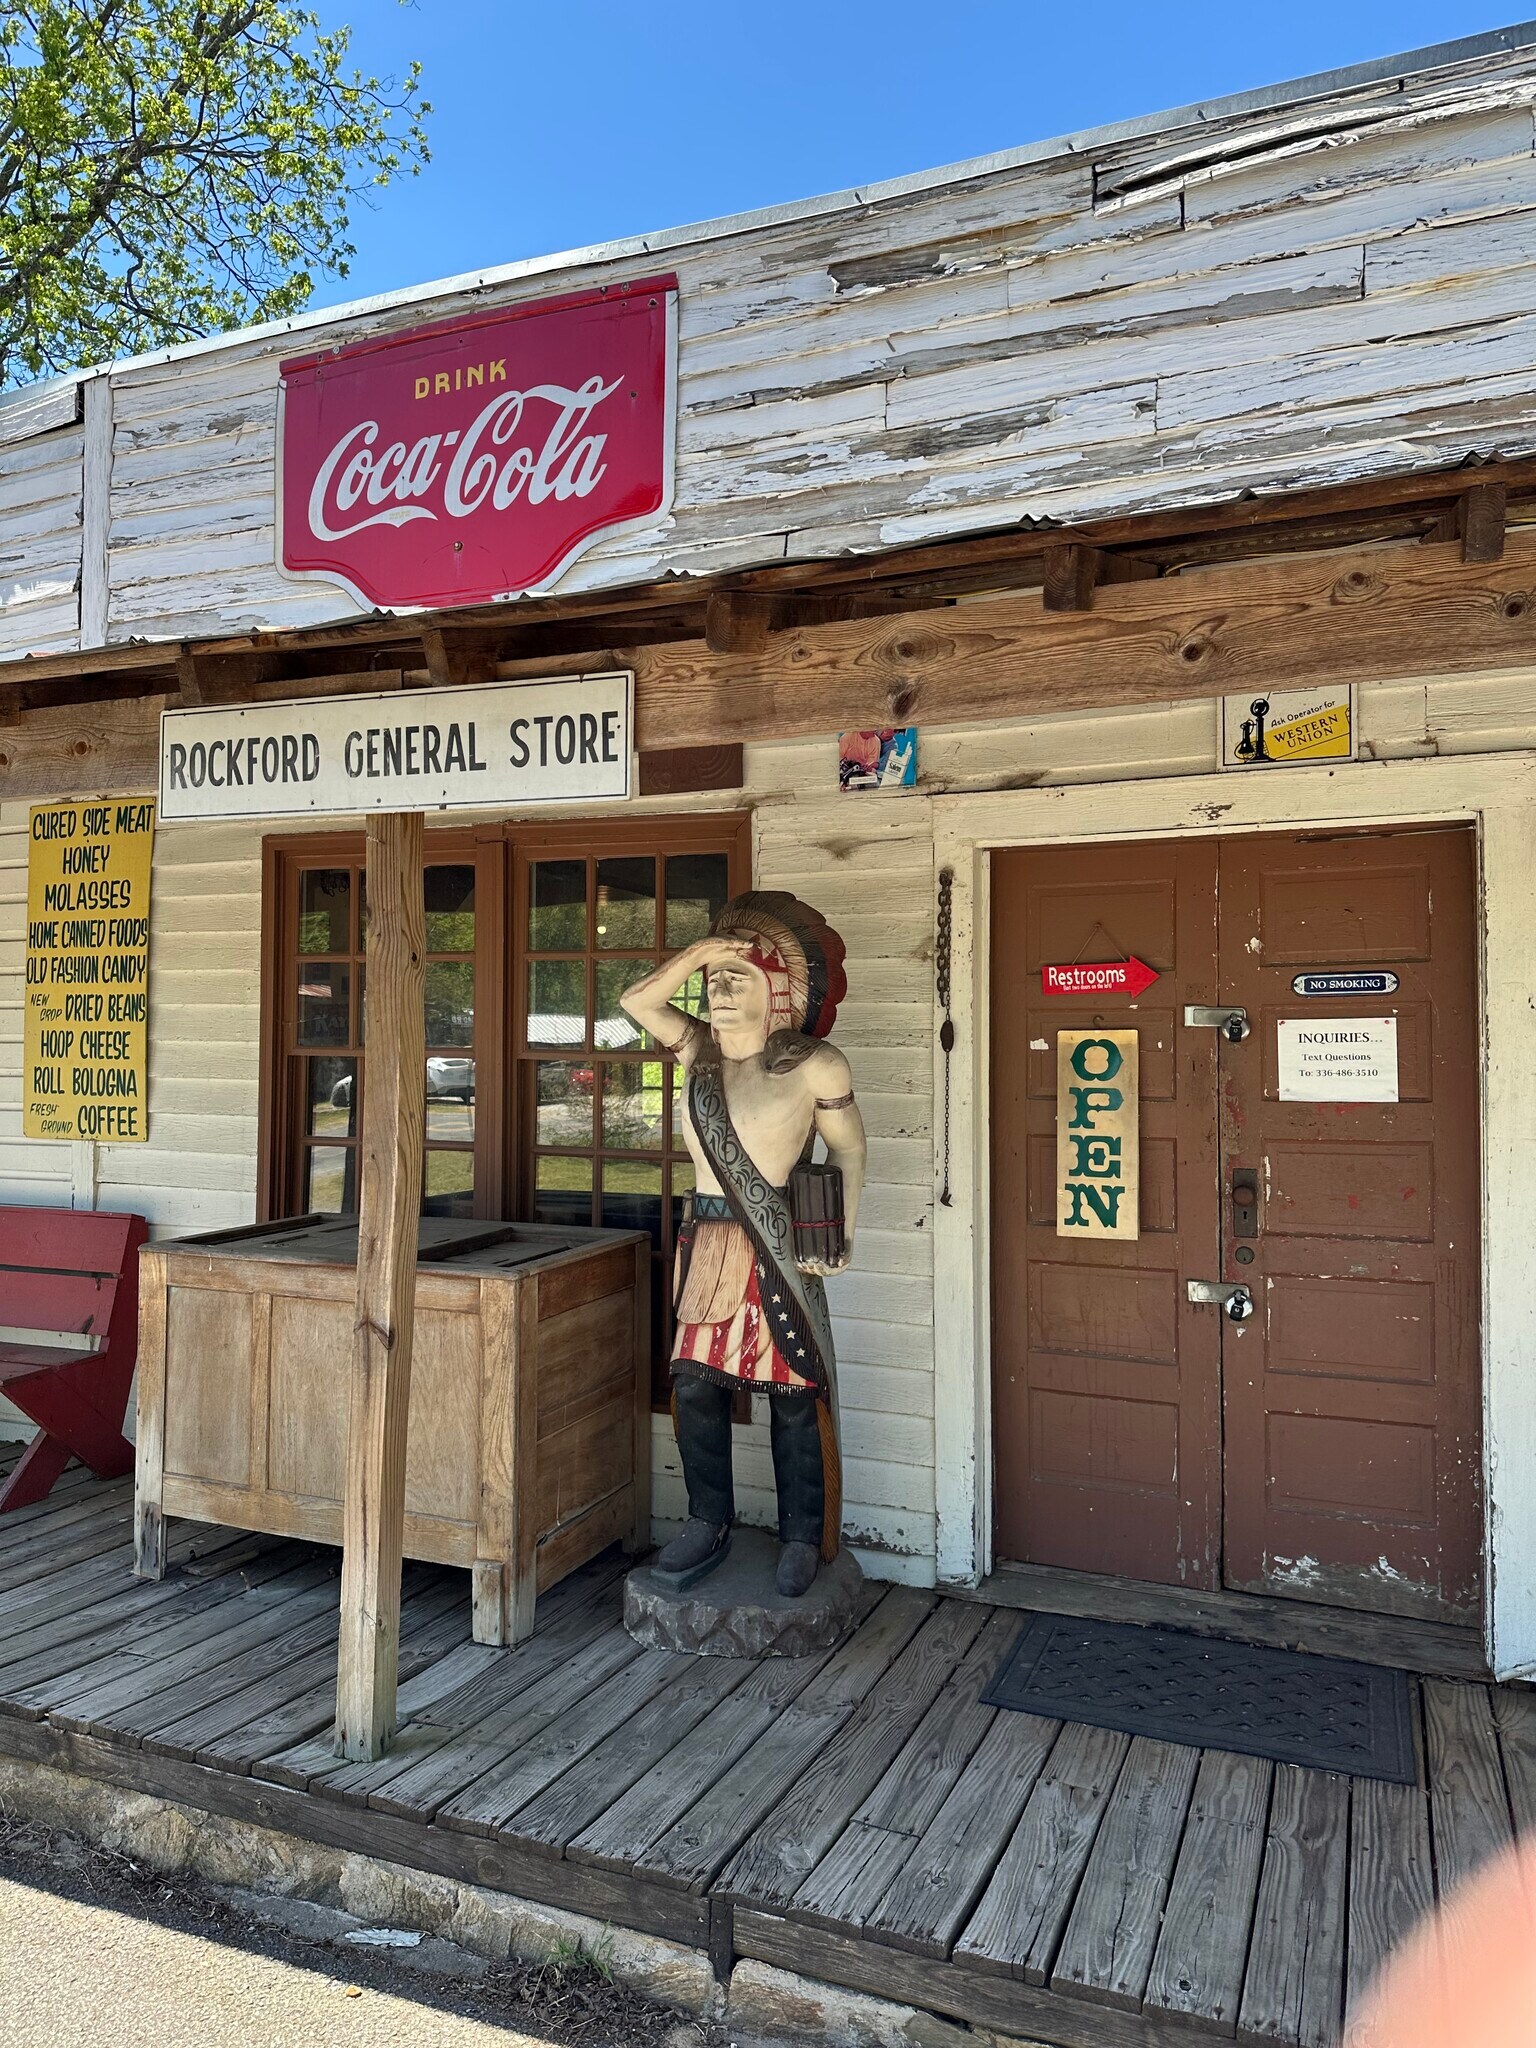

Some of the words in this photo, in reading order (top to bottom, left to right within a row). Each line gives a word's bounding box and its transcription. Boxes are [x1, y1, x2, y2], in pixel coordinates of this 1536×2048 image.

[415, 358, 507, 399] DRINK
[308, 374, 624, 542] Coca-Cola
[1271, 718, 1286, 727] Ask
[1287, 706, 1322, 722] Operator
[1324, 700, 1336, 708] for
[1274, 714, 1338, 743] WESTERN
[1287, 726, 1334, 748] UNION
[170, 733, 320, 790] ROCKFORD
[344, 722, 486, 778] GENERAL
[510, 711, 618, 768] STORE
[32, 809, 76, 840] CURED
[82, 806, 112, 838] SIDE
[115, 804, 155, 834] MEAT
[62, 844, 110, 874] HONEY
[44, 880, 131, 912] MOLASSES
[29, 921, 60, 950] HOME
[62, 919, 106, 948] CANNED
[108, 917, 148, 947] FOODS
[26, 957, 48, 984] OLD
[51, 956, 99, 984] FASHION
[102, 954, 146, 984] CANDY
[1048, 967, 1126, 986] Restrooms
[1310, 980, 1326, 989] NO
[1329, 980, 1380, 989] SMOKING
[30, 994, 50, 1008] NEW
[40, 1007, 62, 1022] CROP
[65, 993, 103, 1022] DRIED
[108, 993, 146, 1022] BEANS
[40, 1030, 74, 1060] HOOP
[80, 1030, 130, 1060] CHEESE
[1298, 1032, 1382, 1044] INQUIRIES...
[1325, 1053, 1371, 1061] Questions
[33, 1066, 65, 1095] ROLL
[72, 1067, 138, 1098] BOLOGNA
[30, 1104, 60, 1116] FRESH
[78, 1105, 138, 1136] COFFEE
[40, 1120, 73, 1134] GROUND
[1064, 1038, 1126, 1228] OPEN
